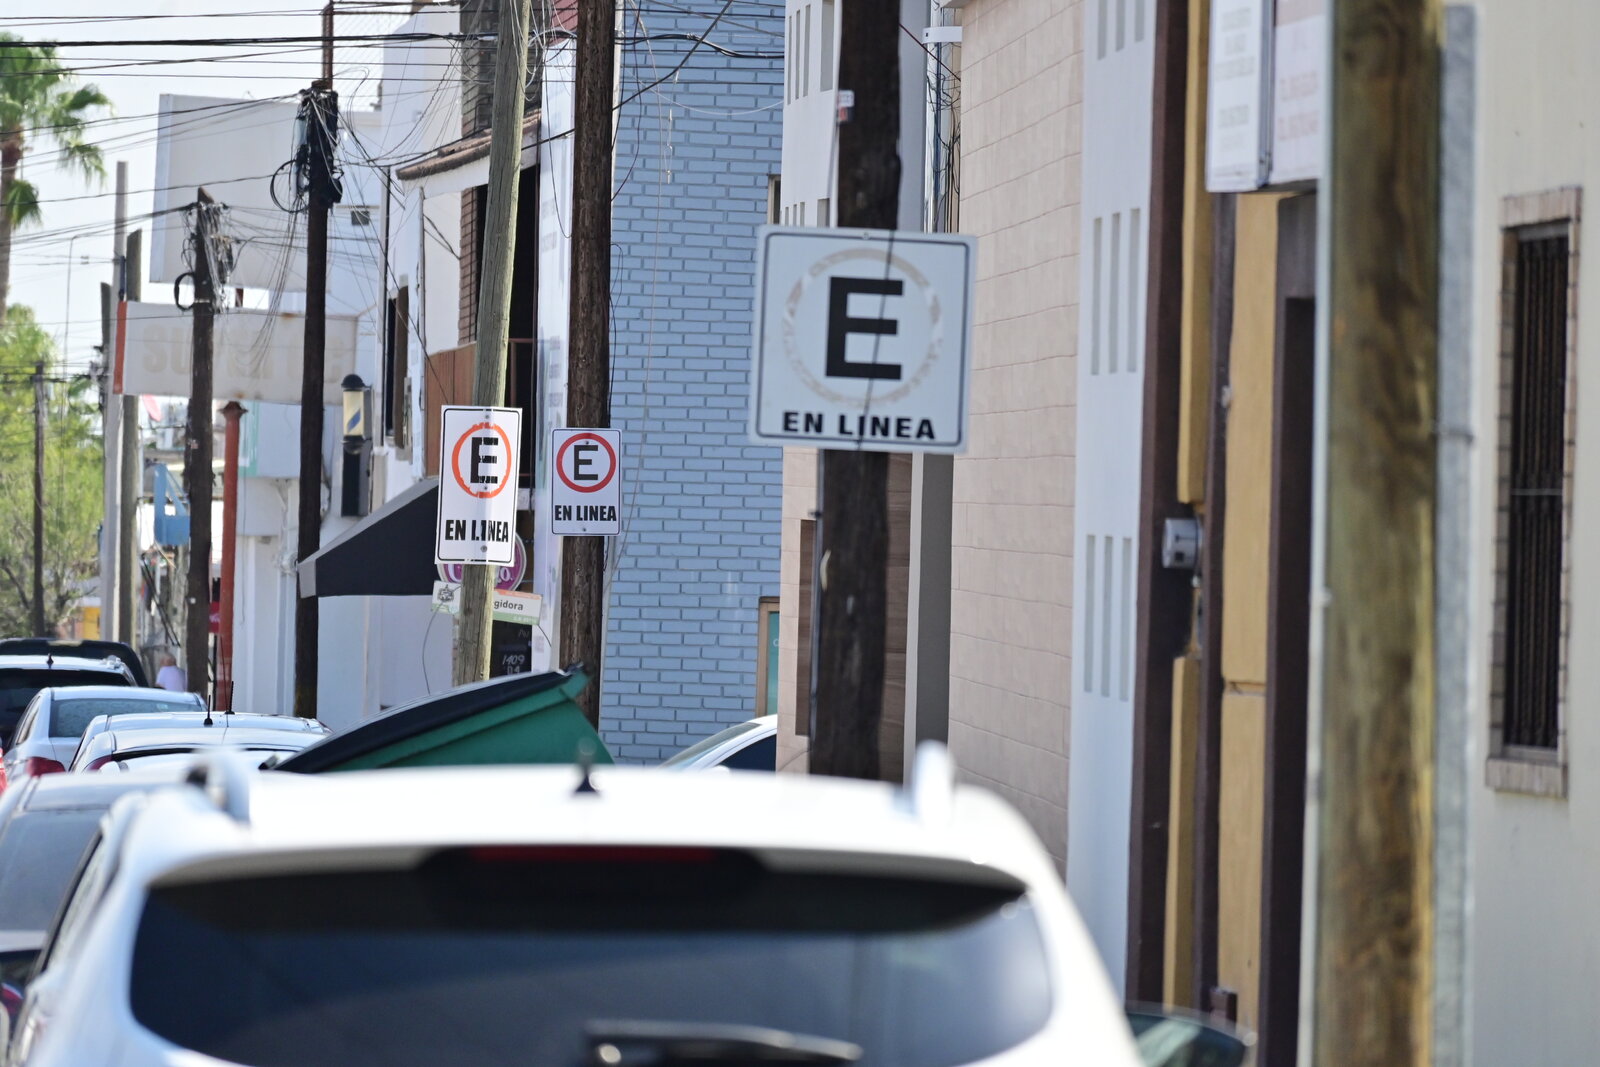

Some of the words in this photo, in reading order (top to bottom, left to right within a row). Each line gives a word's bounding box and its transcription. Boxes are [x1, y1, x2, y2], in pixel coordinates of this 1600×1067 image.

[825, 276, 904, 381] E
[782, 411, 824, 434] EN
[838, 414, 936, 440] LINEA
[471, 437, 499, 484] E
[573, 444, 599, 481] E
[554, 504, 574, 521] EN
[576, 505, 617, 522] LINEA
[445, 519, 467, 541] EN
[471, 519, 509, 543] LINEA
